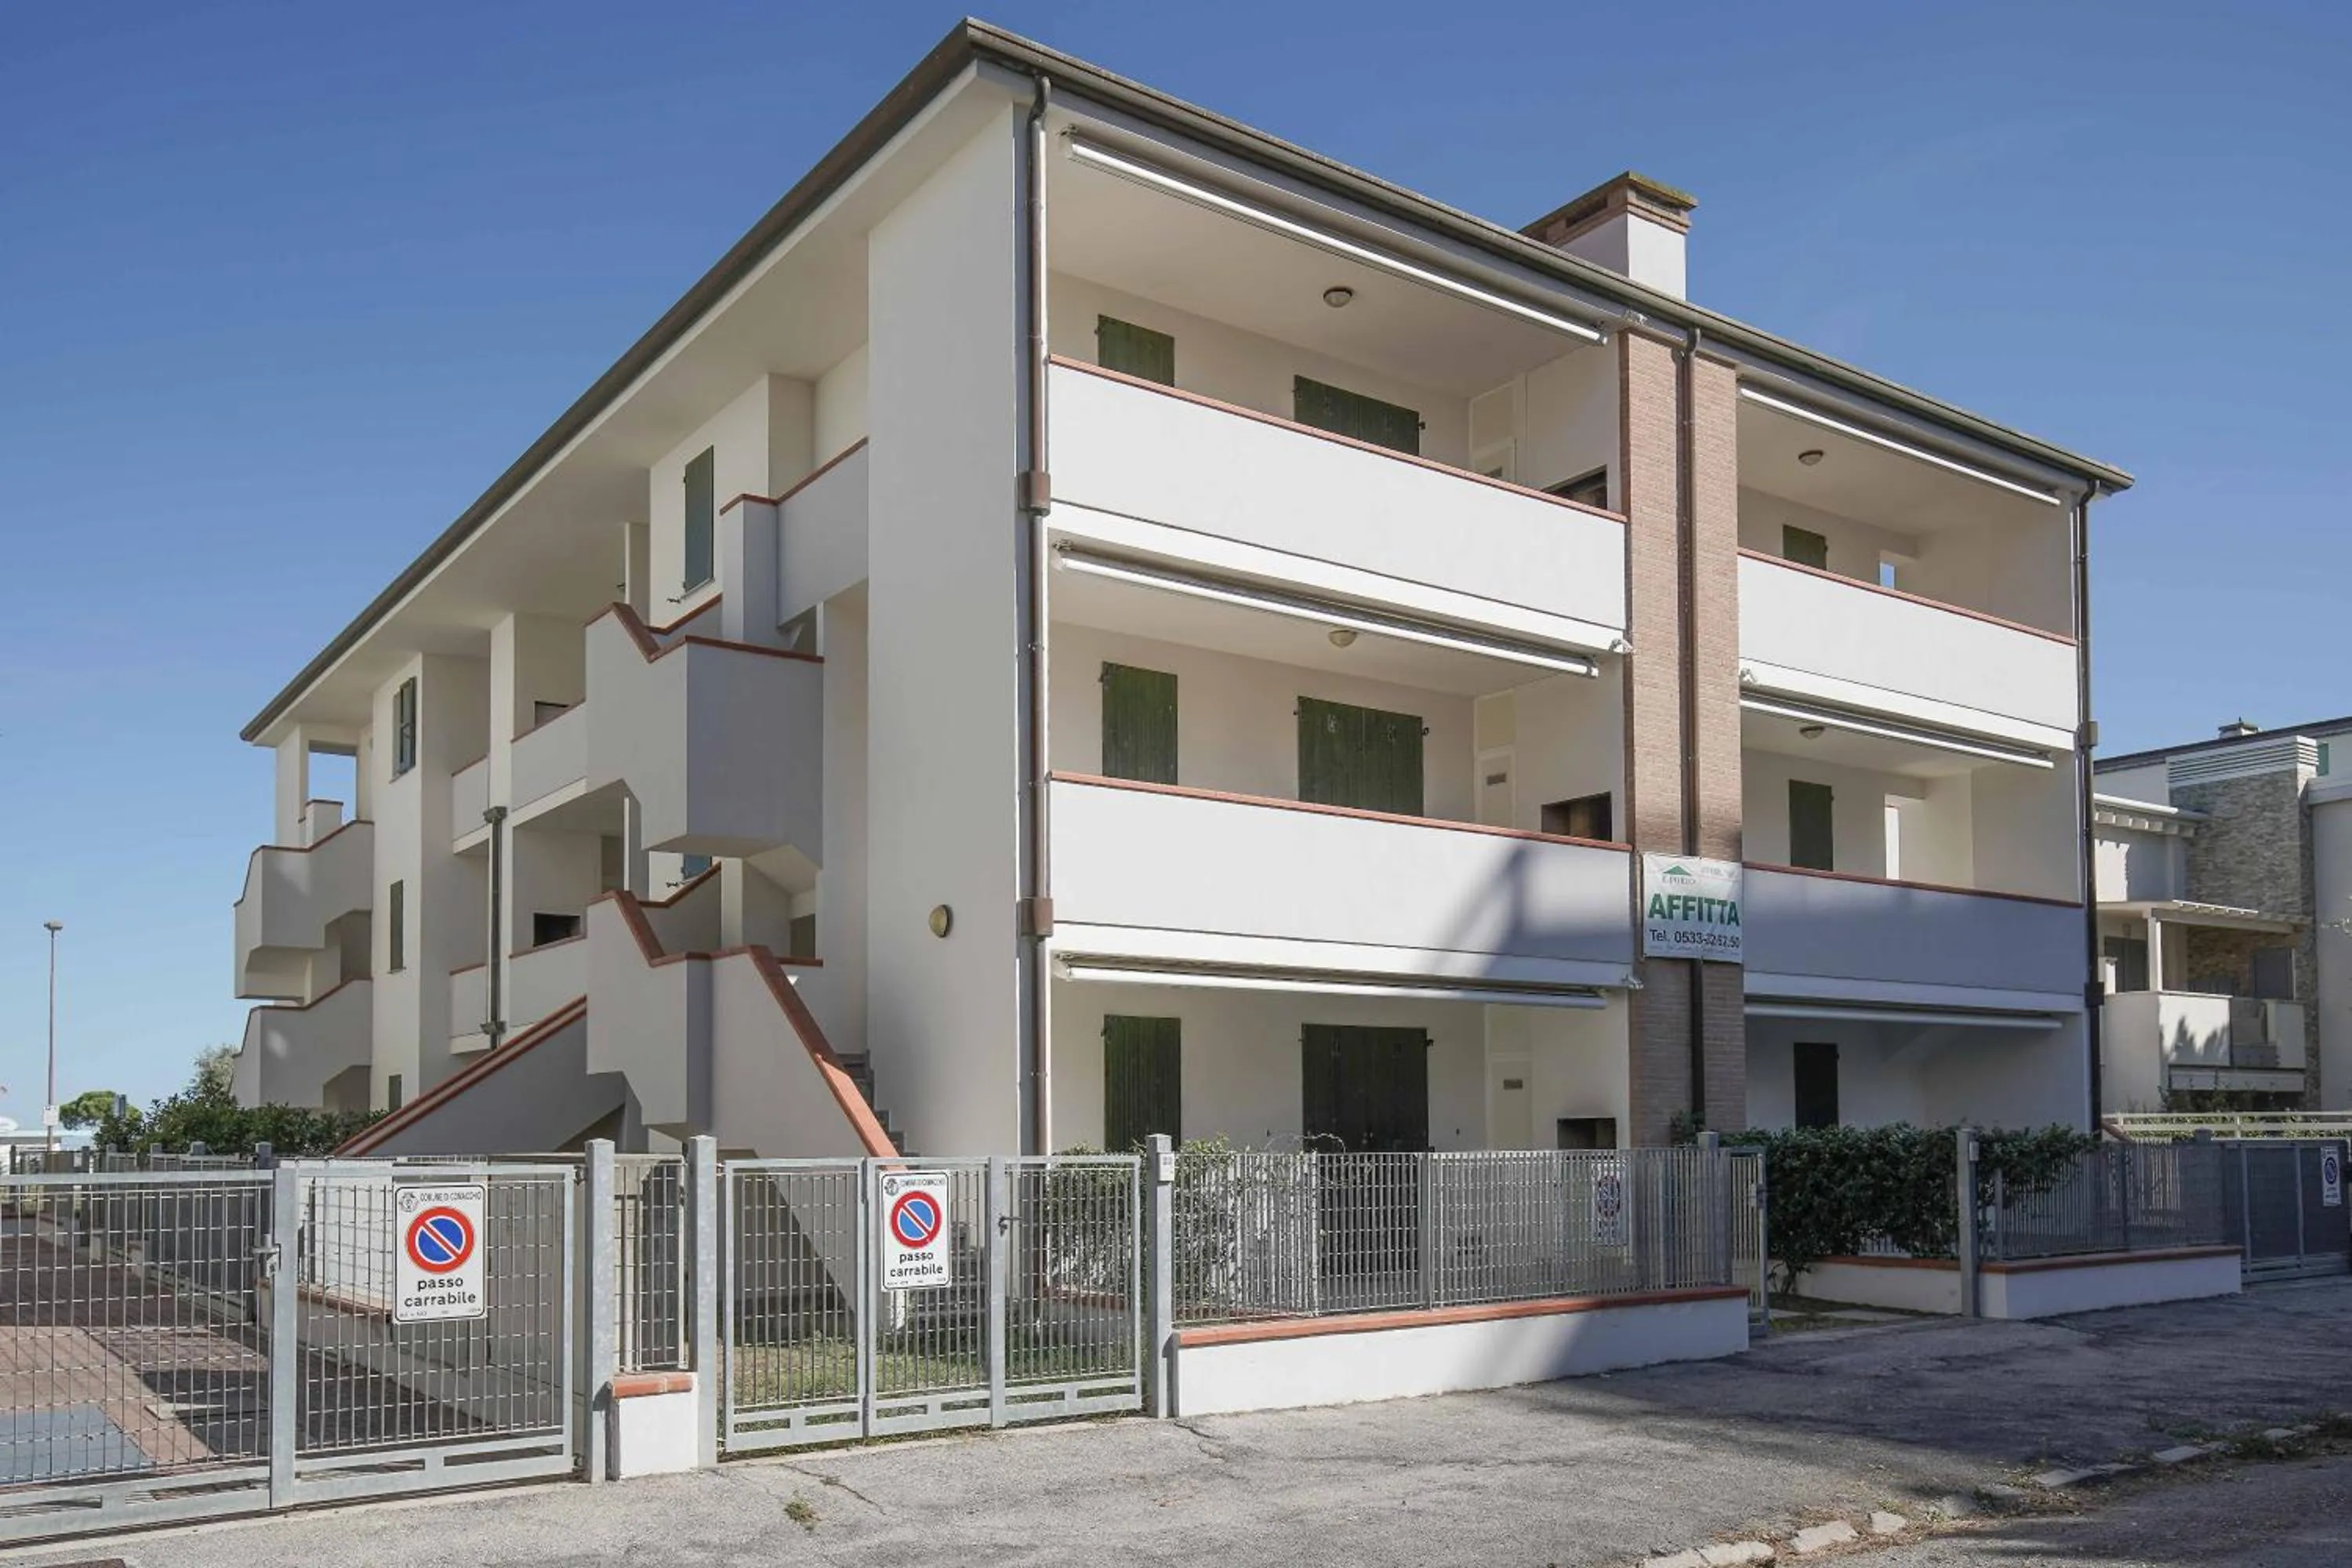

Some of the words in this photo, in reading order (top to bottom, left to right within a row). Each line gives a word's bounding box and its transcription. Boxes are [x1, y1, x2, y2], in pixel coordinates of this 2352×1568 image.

[1648, 893, 1740, 927] AFFITTA
[899, 1252, 934, 1264] passo
[890, 1263, 943, 1277] carrabile
[417, 1276, 463, 1292] passo
[404, 1291, 476, 1307] carrabile
